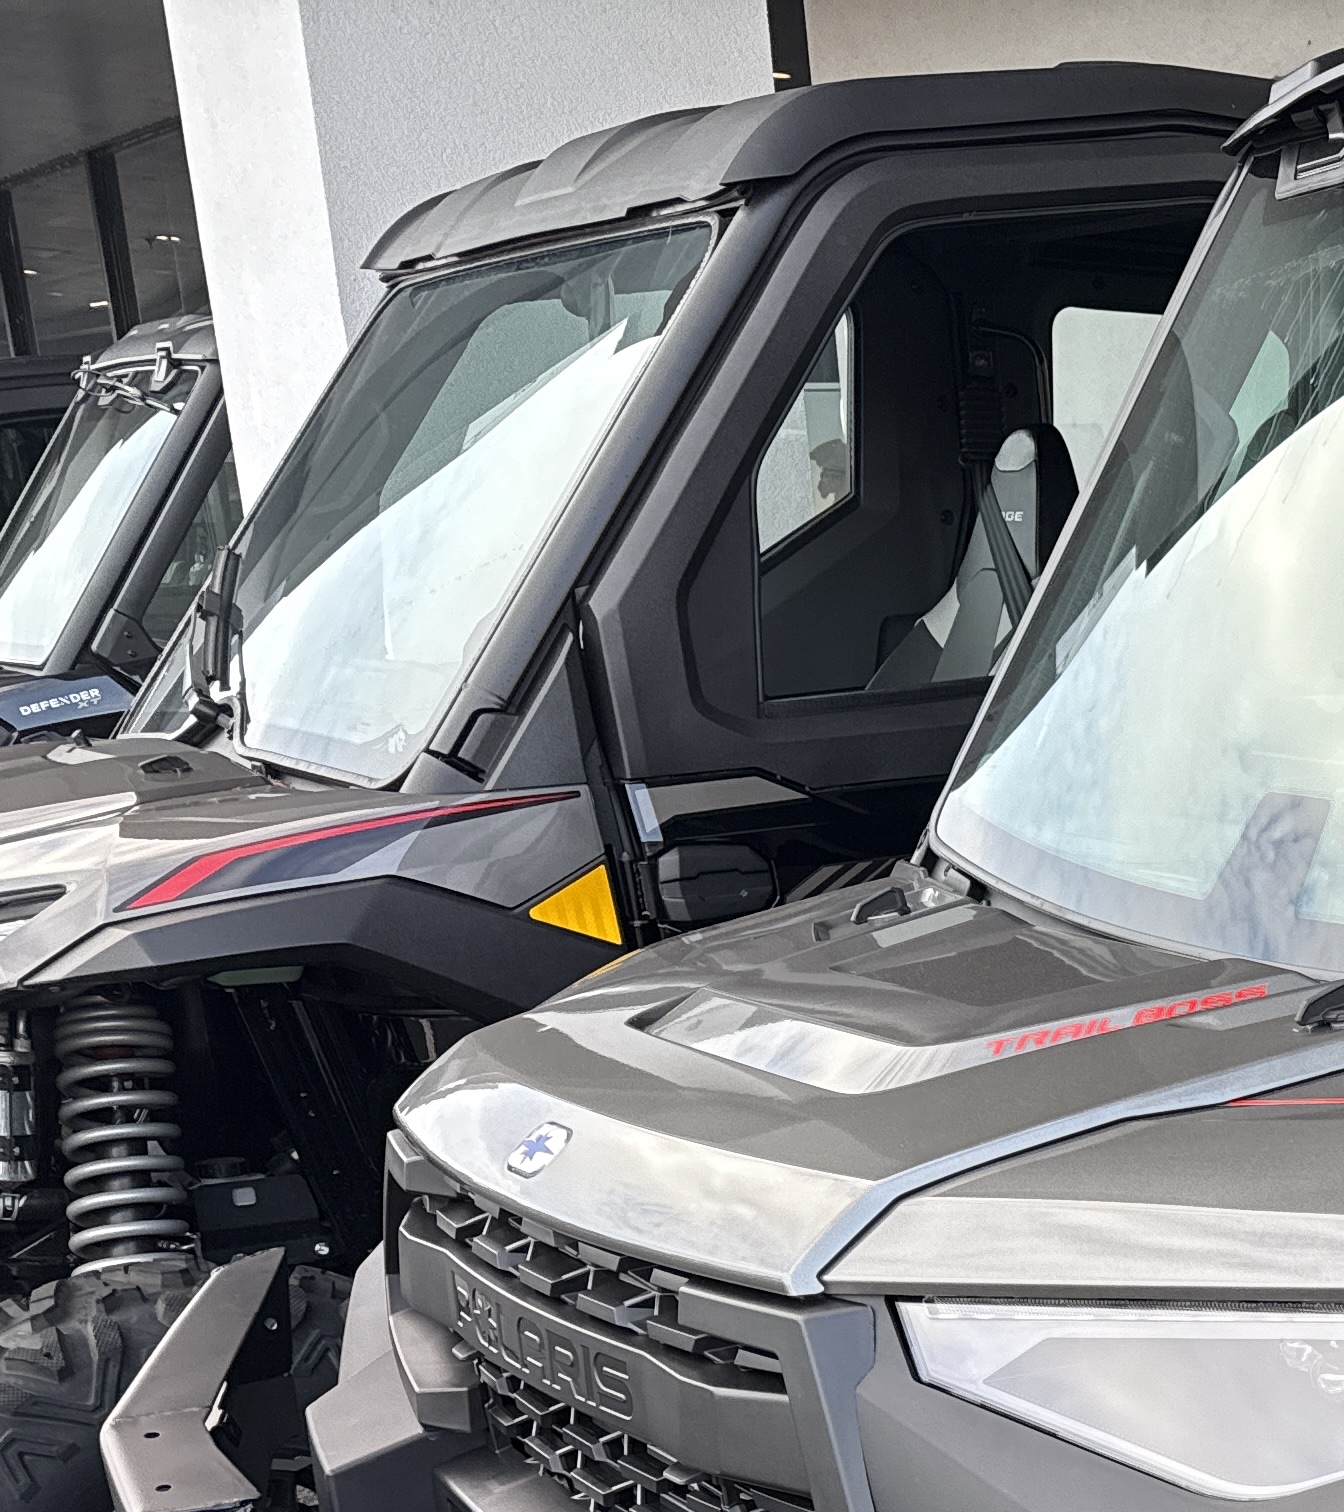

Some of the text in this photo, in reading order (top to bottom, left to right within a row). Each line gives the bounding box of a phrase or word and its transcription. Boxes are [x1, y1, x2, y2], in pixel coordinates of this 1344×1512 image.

[19, 688, 101, 716] DEFENDER
[986, 984, 1269, 1057] TRAIL BOSS
[451, 1270, 633, 1421] POLARIS
